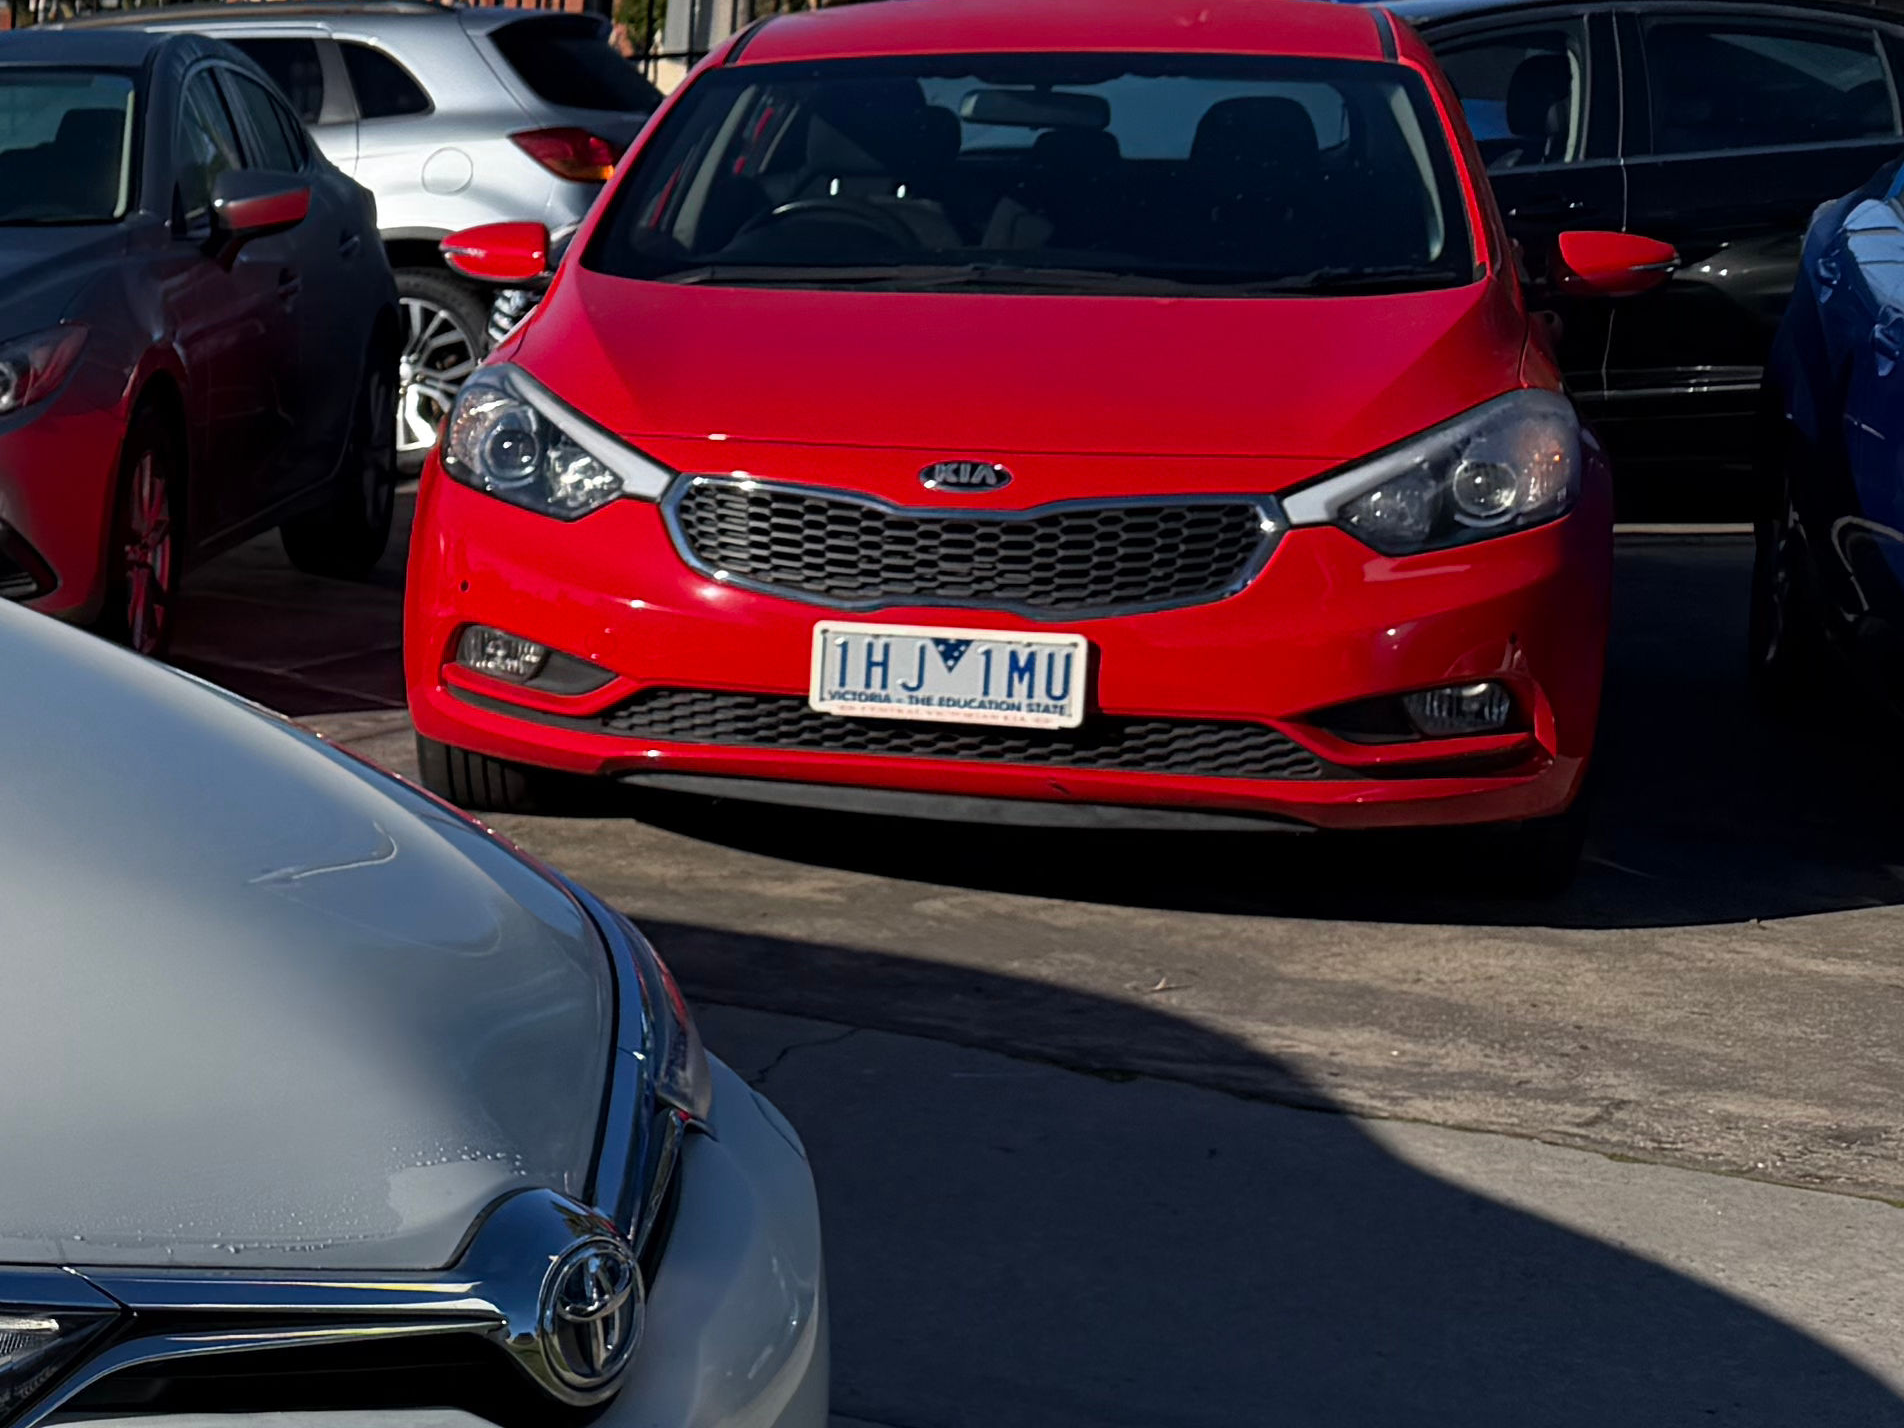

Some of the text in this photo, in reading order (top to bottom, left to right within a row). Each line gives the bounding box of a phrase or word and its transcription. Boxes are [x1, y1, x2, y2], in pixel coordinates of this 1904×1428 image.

[933, 463, 998, 485] KIA
[834, 636, 1073, 702] 1HJ 1MU
[828, 689, 892, 704] VICTORIA
[907, 695, 934, 707] THE
[938, 696, 1022, 714] EDUCATION
[1026, 702, 1068, 717] STATE
